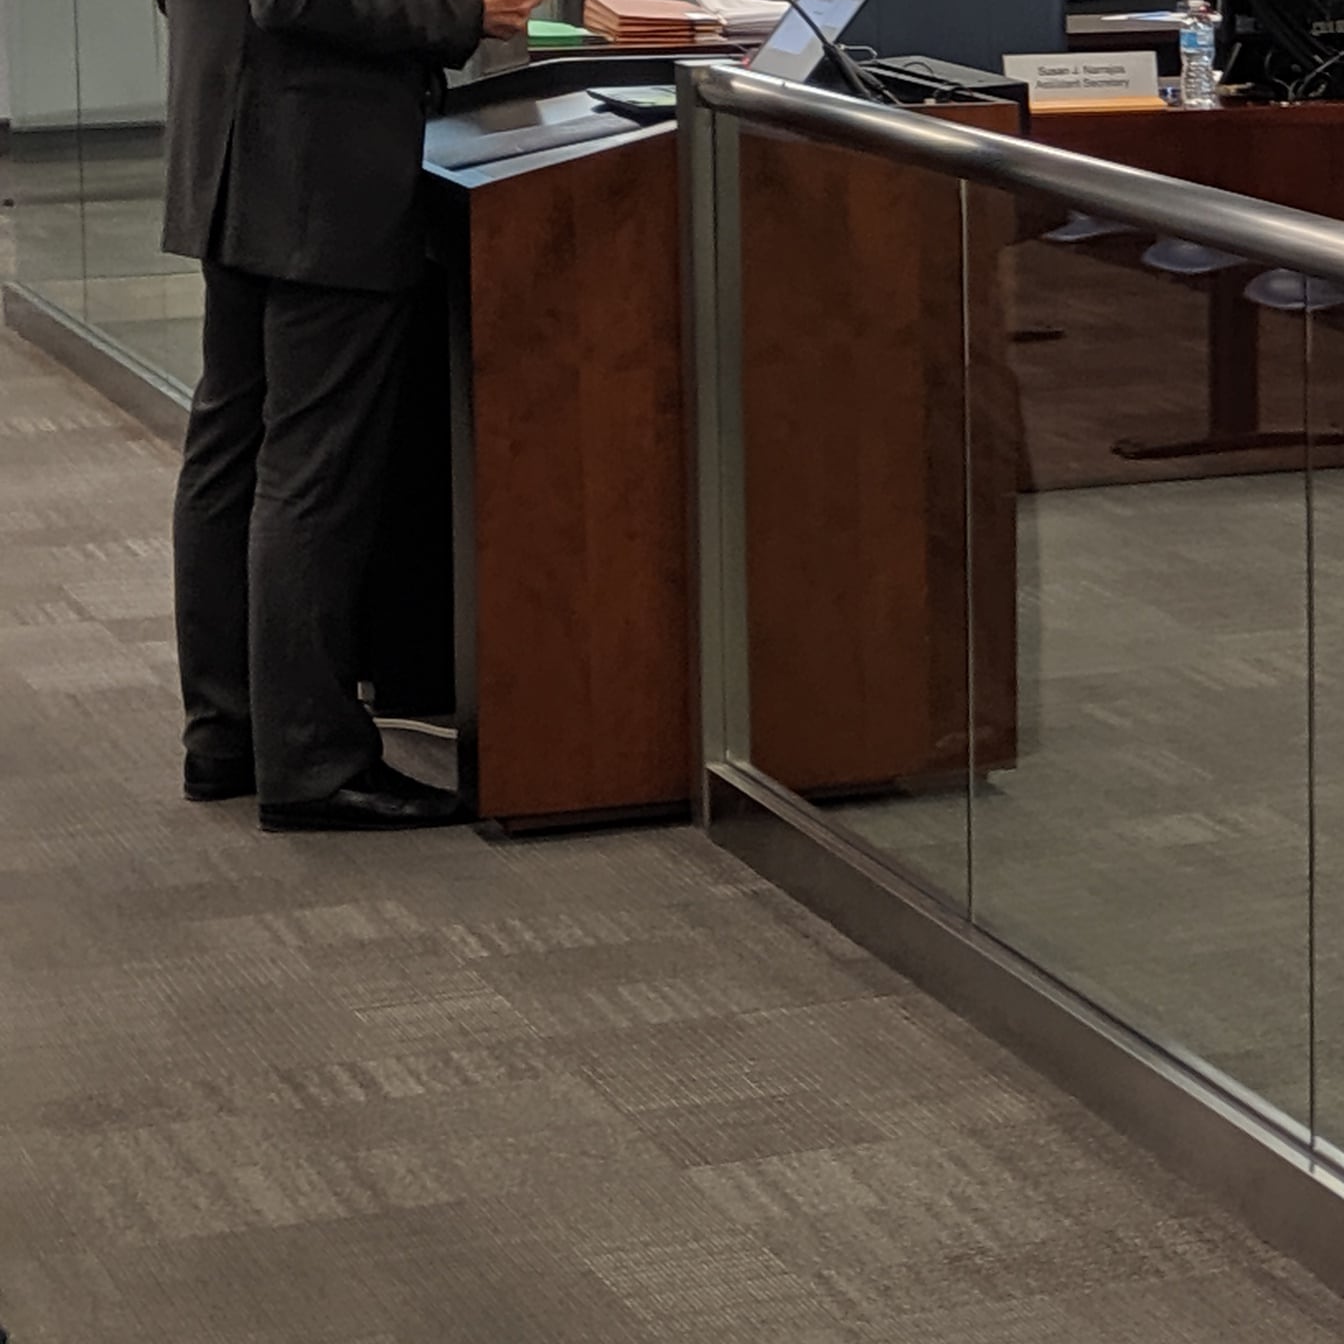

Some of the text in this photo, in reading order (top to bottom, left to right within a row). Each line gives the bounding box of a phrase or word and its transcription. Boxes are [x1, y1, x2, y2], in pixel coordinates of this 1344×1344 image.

[1037, 66, 1070, 76] Susan
[1035, 78, 1129, 89] Assistant Secretary
